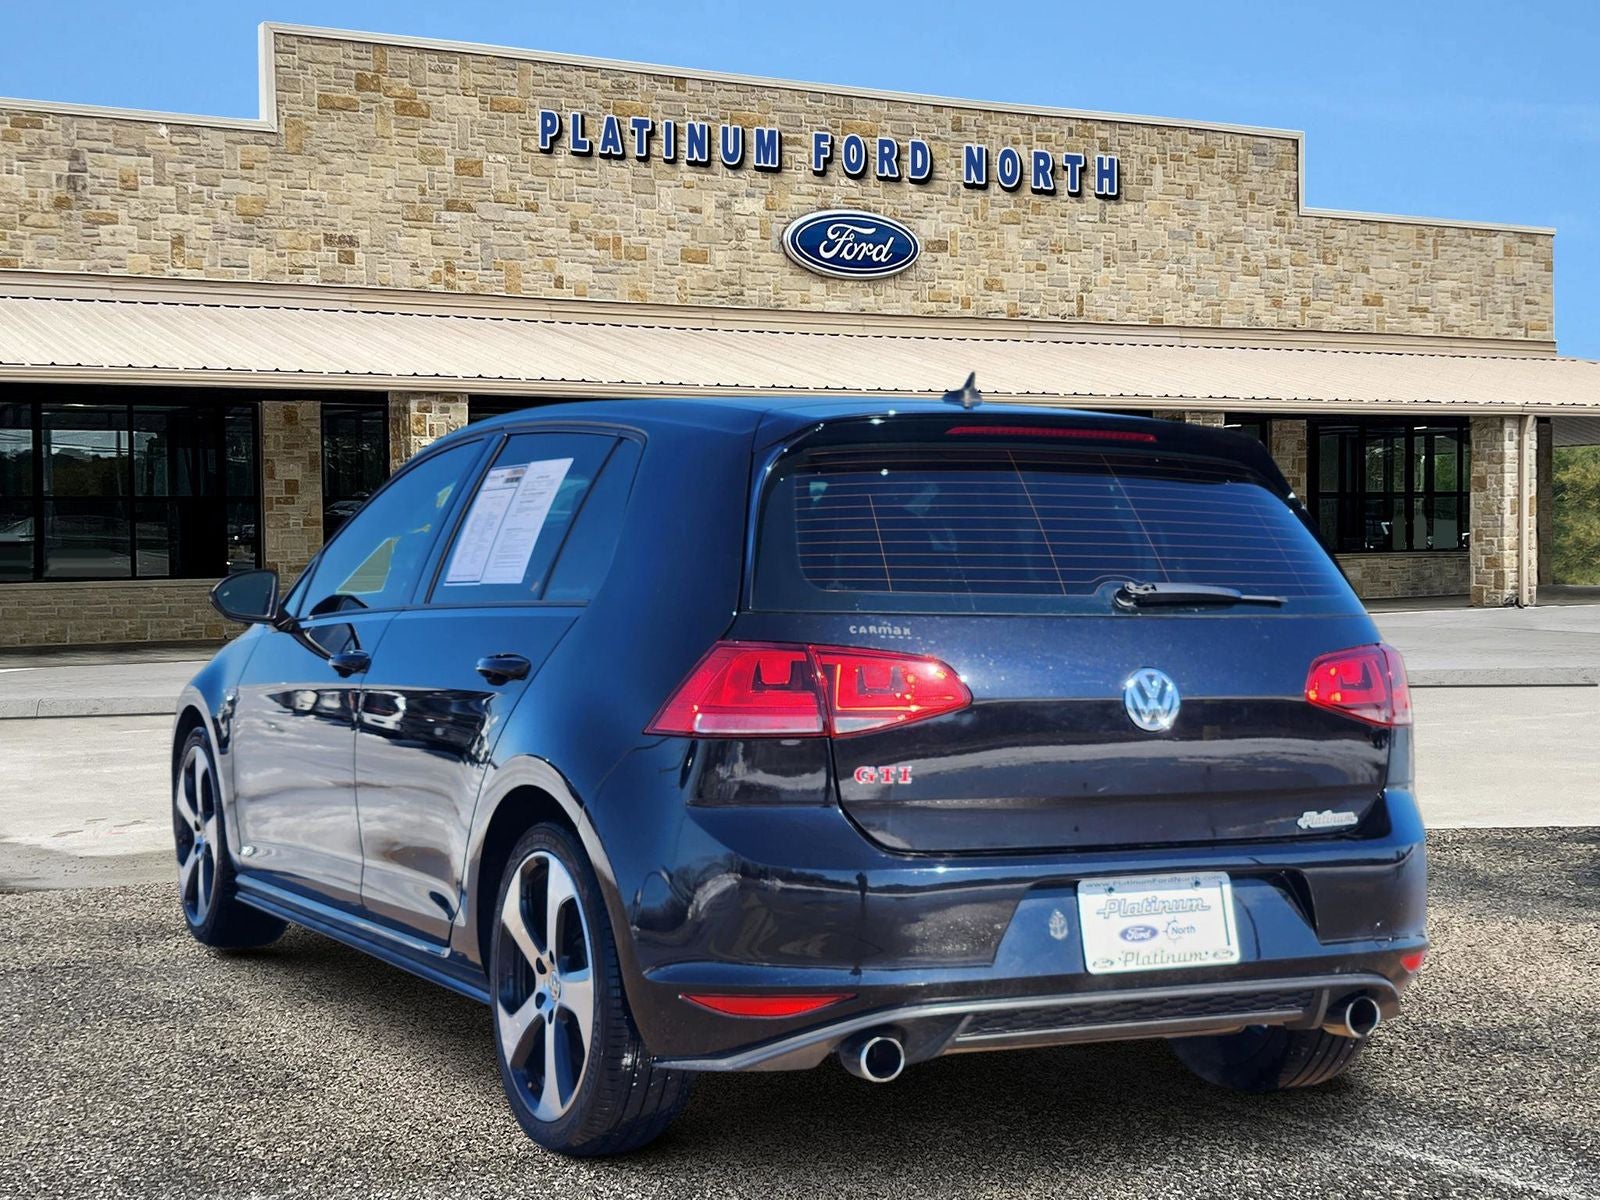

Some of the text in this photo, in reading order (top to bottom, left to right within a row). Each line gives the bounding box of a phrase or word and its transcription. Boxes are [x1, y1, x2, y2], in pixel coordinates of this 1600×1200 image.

[538, 110, 1120, 198] PLATINUM FORD NORTH
[819, 223, 894, 263] Ford
[854, 766, 912, 784] GTI
[1096, 896, 1211, 919] Platinum
[1126, 926, 1152, 942] Ford
[1171, 926, 1196, 935] North
[1122, 949, 1203, 967] Platinum
